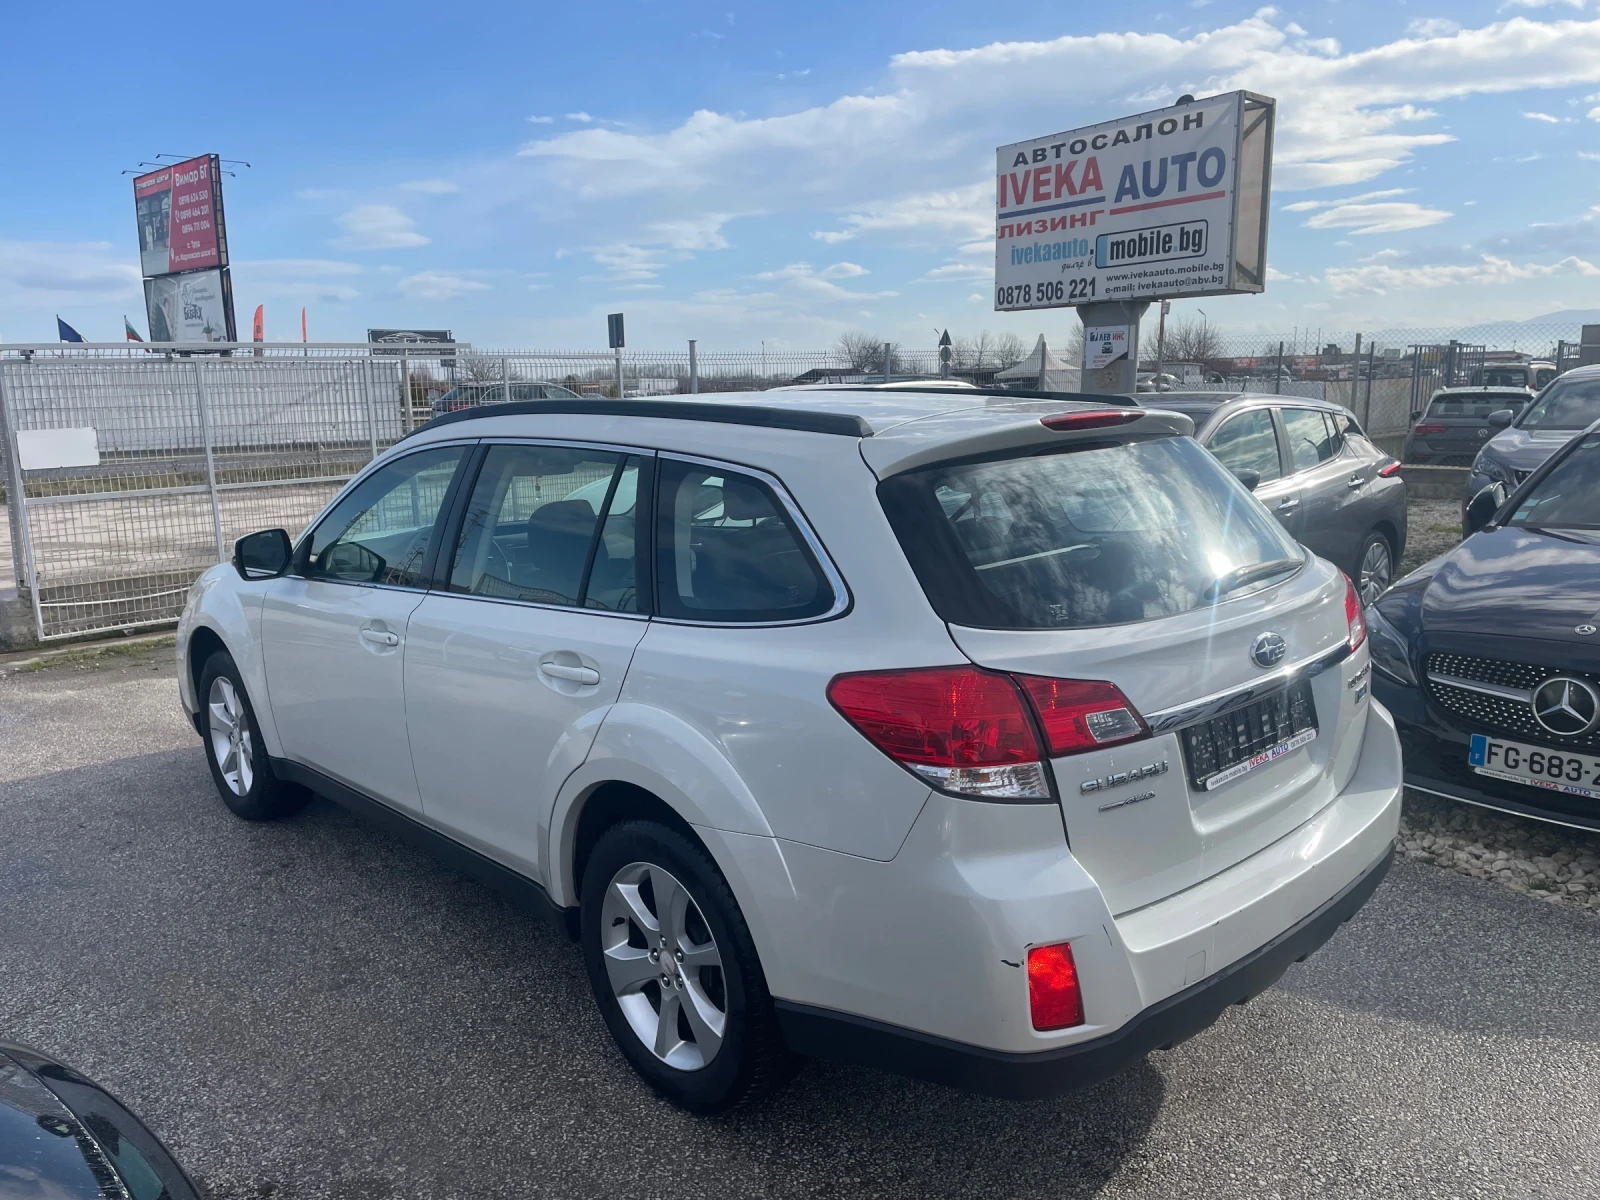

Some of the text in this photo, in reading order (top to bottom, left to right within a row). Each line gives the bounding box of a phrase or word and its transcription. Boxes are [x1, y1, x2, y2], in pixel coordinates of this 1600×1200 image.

[1012, 111, 1204, 168] АВТОСАЛОН
[175, 164, 208, 187] Вимар БГ
[1000, 146, 1227, 208] IVEKA AUTO
[998, 209, 1105, 239] ЛИЗИНГ
[1110, 226, 1204, 261] mobile.bg
[1105, 275, 1224, 294] e-mail: ivekaauto@abv.bg
[1106, 262, 1224, 283] www.ivekaauto.mobile.bg
[997, 276, 1096, 306] 0878 506 221
[1099, 331, 1125, 342] ЛЕВ ИНС
[1248, 752, 1270, 768] IVEKA
[1271, 742, 1289, 758] AUTO
[1080, 760, 1169, 795] SUBARU
[1530, 778, 1559, 790] IVEKA
[1563, 786, 1592, 796] AUTO
